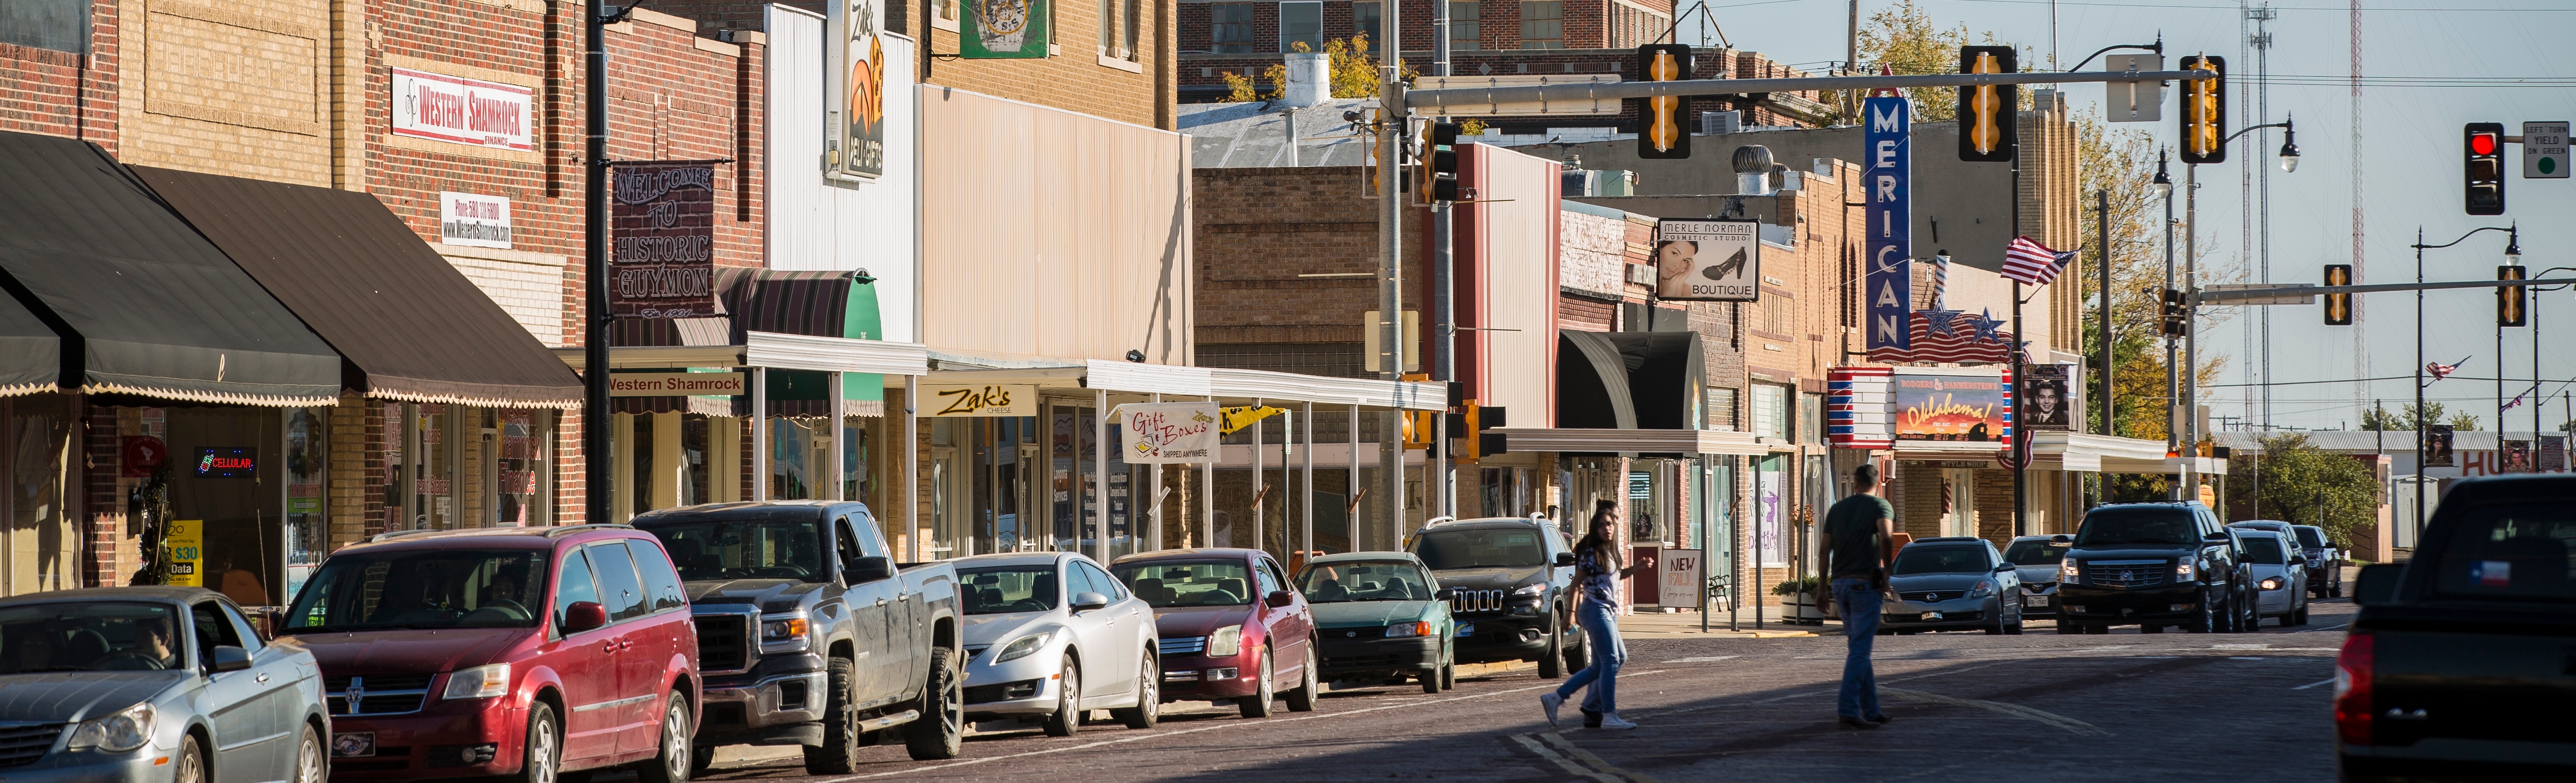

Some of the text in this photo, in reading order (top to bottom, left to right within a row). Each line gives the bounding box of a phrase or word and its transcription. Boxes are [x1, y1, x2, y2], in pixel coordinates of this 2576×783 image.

[419, 85, 521, 136] WESTERN SHAMROCK
[485, 136, 508, 146] FINANCE
[2534, 136, 2559, 145] YIELD
[614, 167, 712, 204] WELCOME
[455, 199, 469, 217] Phone:
[469, 200, 479, 218] 580
[487, 202, 500, 221] 6800
[648, 200, 678, 230] TO
[443, 219, 509, 243] www.WesternShamrock.com
[1665, 224, 1751, 233] MERLE NORMAN
[617, 234, 709, 263] HISTORIC
[617, 263, 709, 298] GUYMON
[1692, 285, 1752, 295] BOUTIQUE
[664, 309, 693, 317] 1901
[667, 378, 741, 390] Shamrock
[1901, 378, 1998, 391] RODGERS & HAMMERSTEIN'S
[936, 385, 1011, 416] Zak's
[1907, 392, 1994, 428] Oklahoma!
[1132, 411, 1165, 435] Gift
[423, 424, 441, 444] Loans
[1160, 422, 1207, 446] Boxes
[497, 429, 541, 460] Shamrock
[1182, 449, 1208, 457] ANYWHERE
[212, 458, 251, 468] CELLULAR
[499, 462, 536, 495] Finance
[1054, 465, 1068, 483] Longoria
[416, 474, 450, 495] redit Starter
[1054, 489, 1068, 503] Services
[176, 546, 198, 560] $30
[171, 564, 192, 573] Data
[1670, 557, 1695, 572] NEW
[1668, 572, 1693, 586] FALL
[1663, 587, 1678, 600] Come
